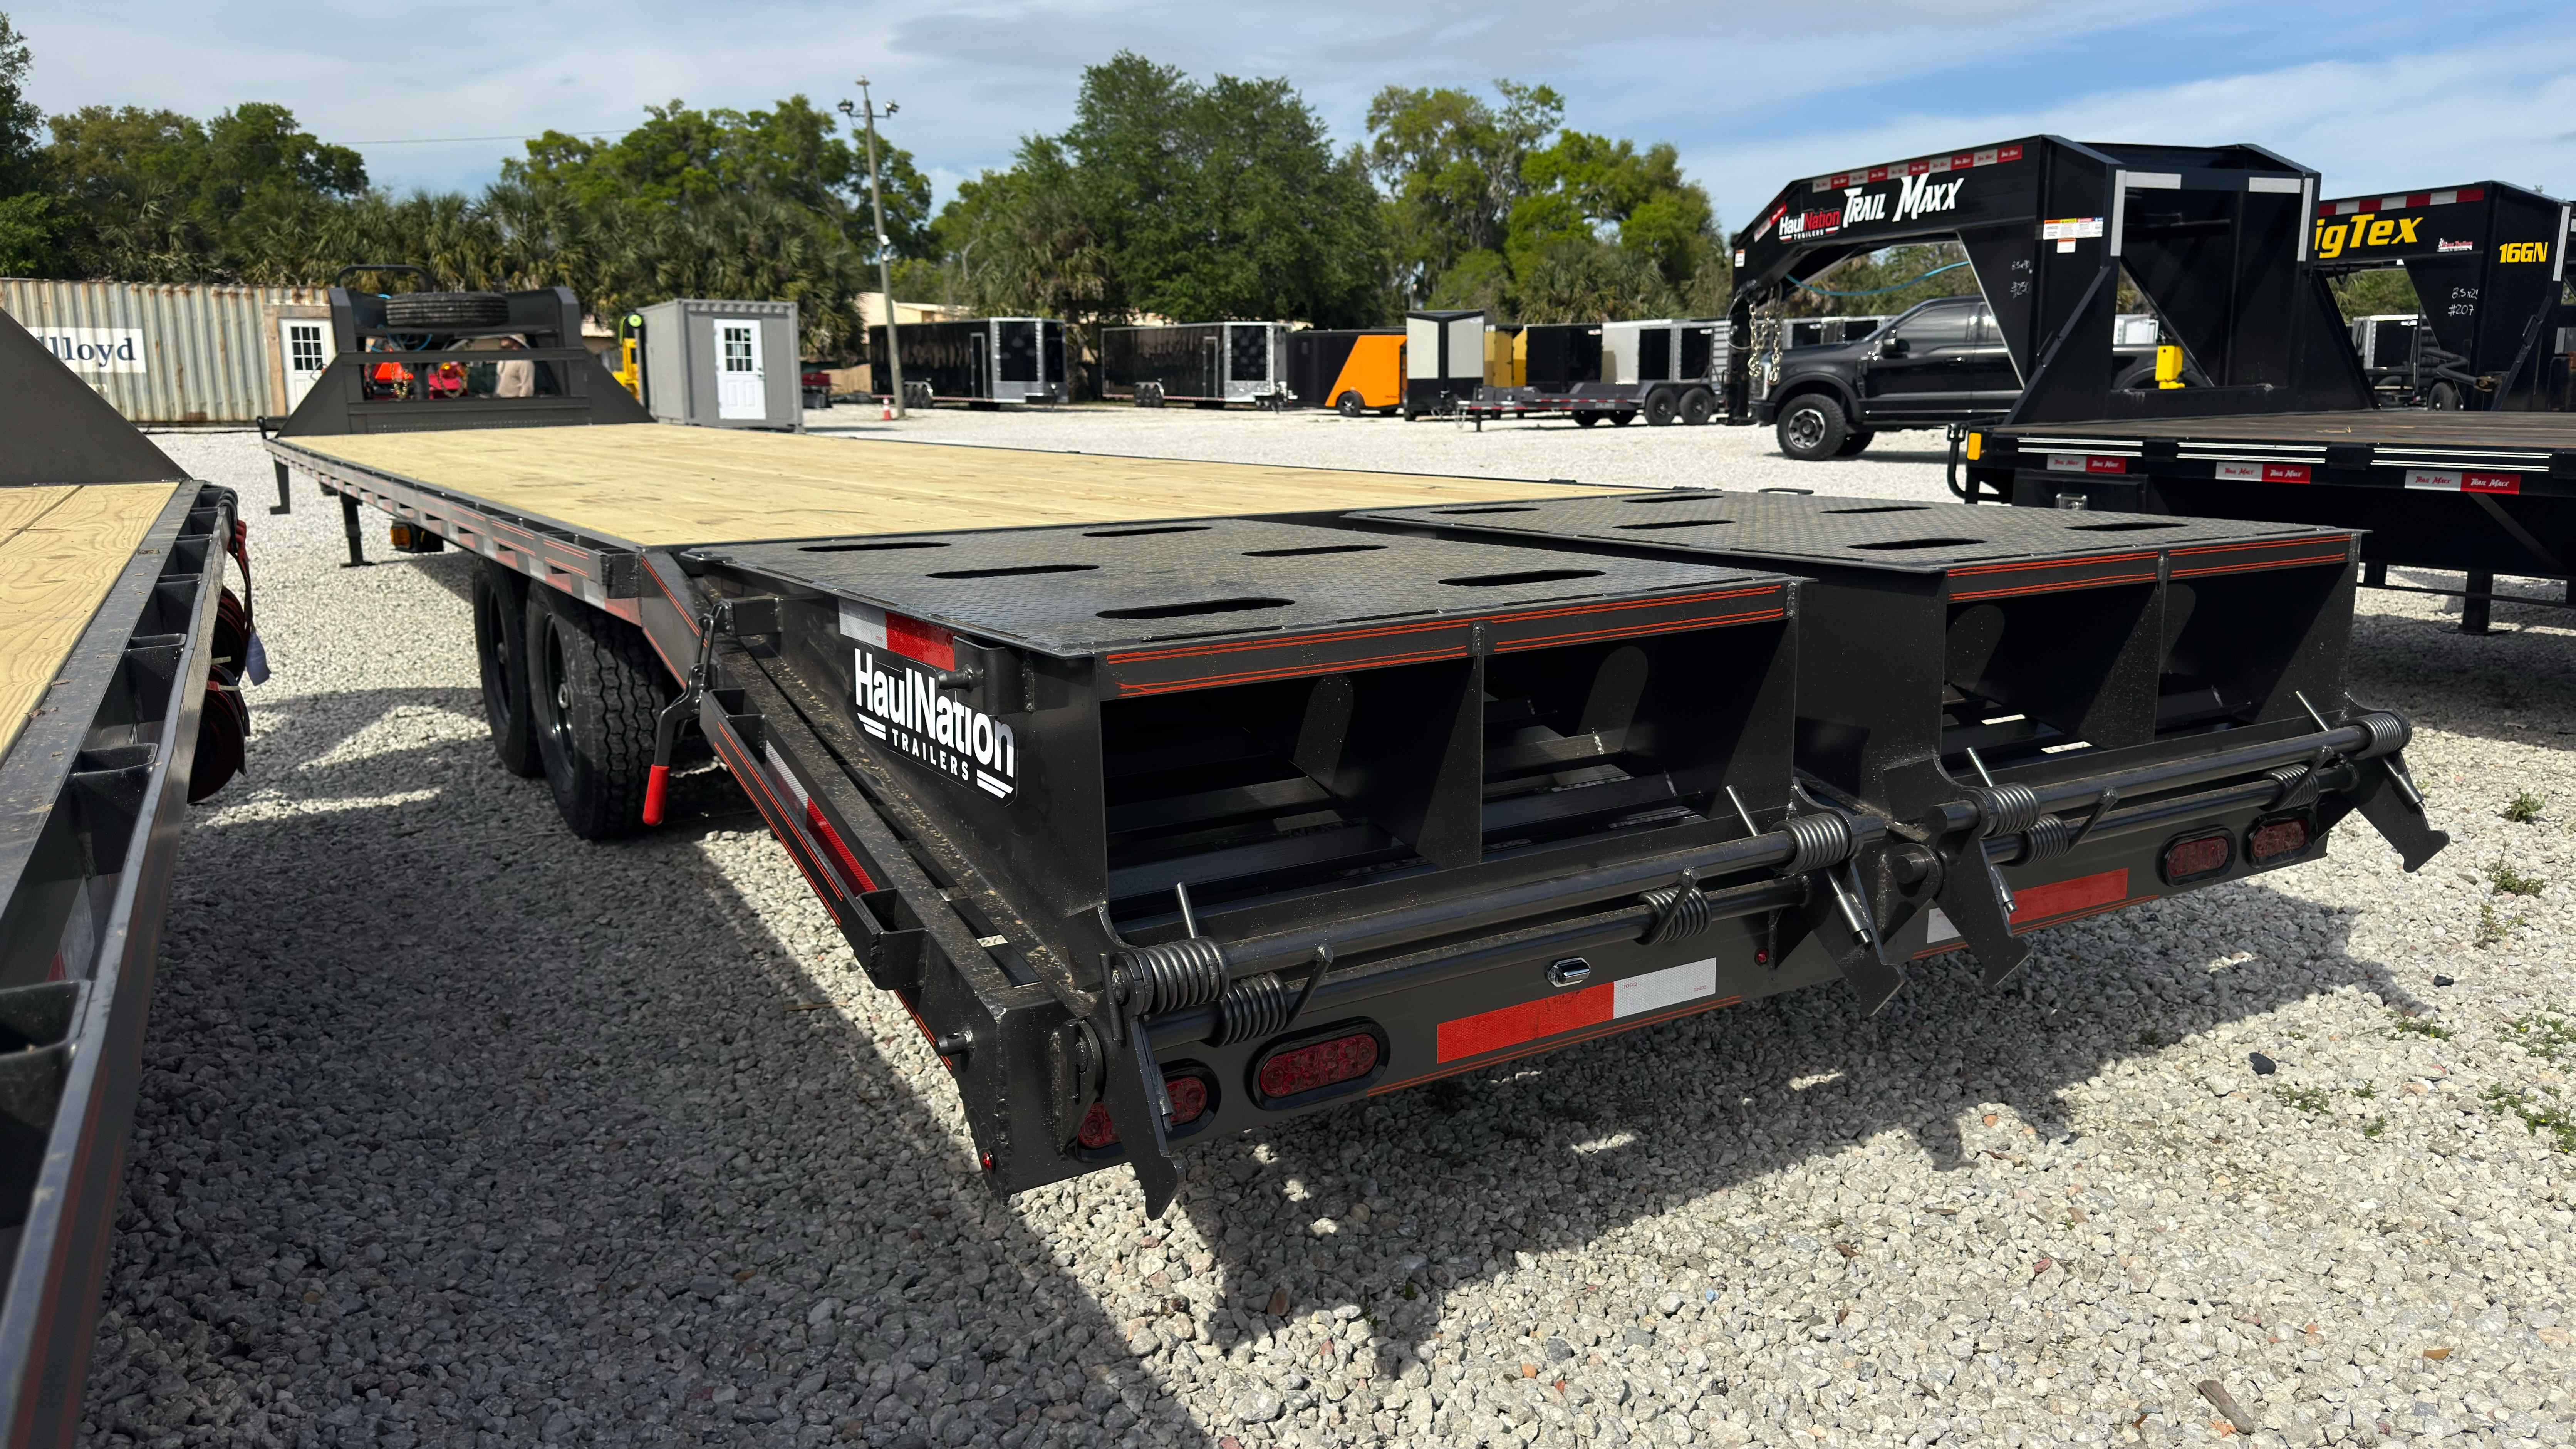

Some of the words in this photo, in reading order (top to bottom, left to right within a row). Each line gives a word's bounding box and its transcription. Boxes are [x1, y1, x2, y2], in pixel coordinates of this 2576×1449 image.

[1842, 187, 1886, 228] TRAIL
[1892, 173, 1964, 222] MAXX
[1779, 210, 1840, 235] HaulNation
[1793, 230, 1824, 240] TRAILERS
[2499, 242, 2548, 263] 16GN
[2448, 304, 2474, 317] #207
[36, 336, 136, 367] lloyd
[855, 648, 1014, 778] HaulNation
[892, 729, 969, 781] TRAILERS
